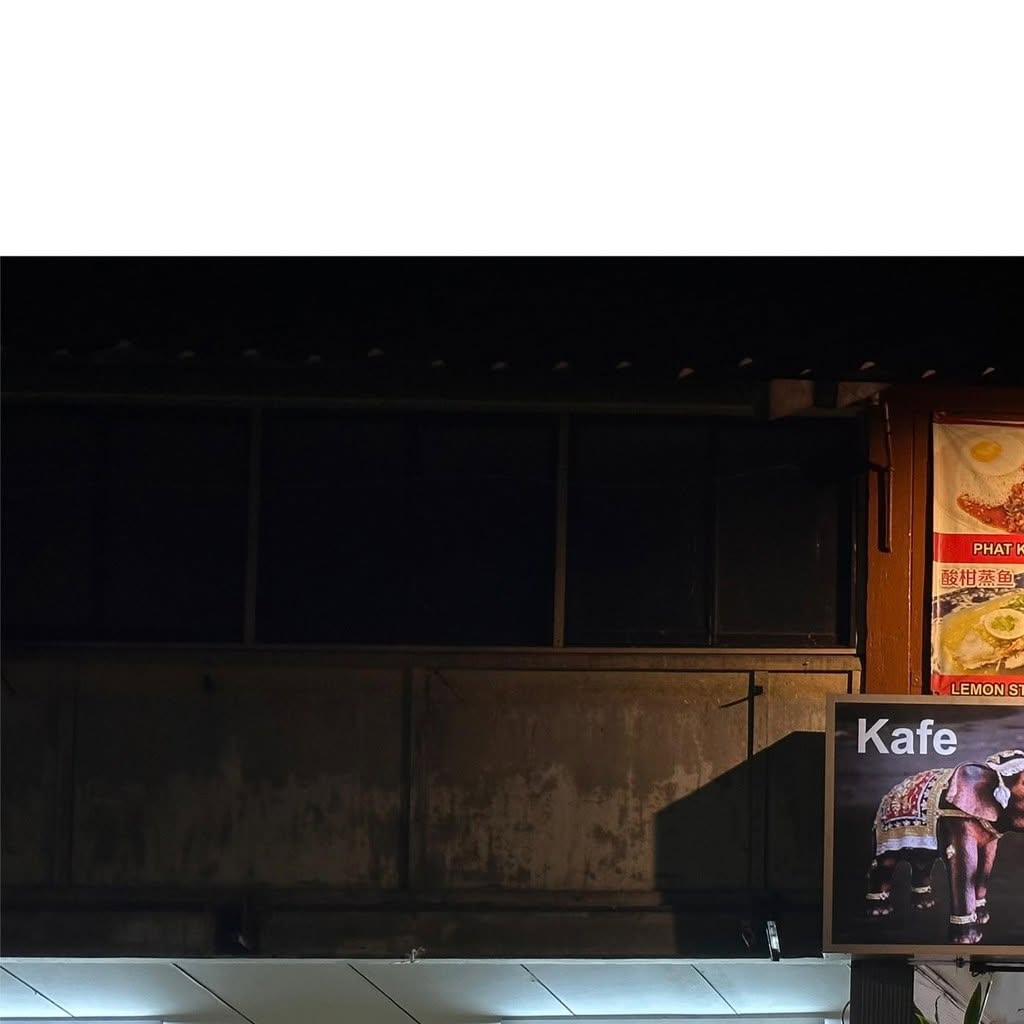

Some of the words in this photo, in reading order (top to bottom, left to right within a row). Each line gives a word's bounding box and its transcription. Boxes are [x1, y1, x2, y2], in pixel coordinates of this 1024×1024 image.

[973, 542, 1012, 557] PHAT
[940, 568, 1014, 588] 酸柑蒸鱼
[951, 682, 1005, 697] LEMON
[857, 717, 958, 756] Kafe
